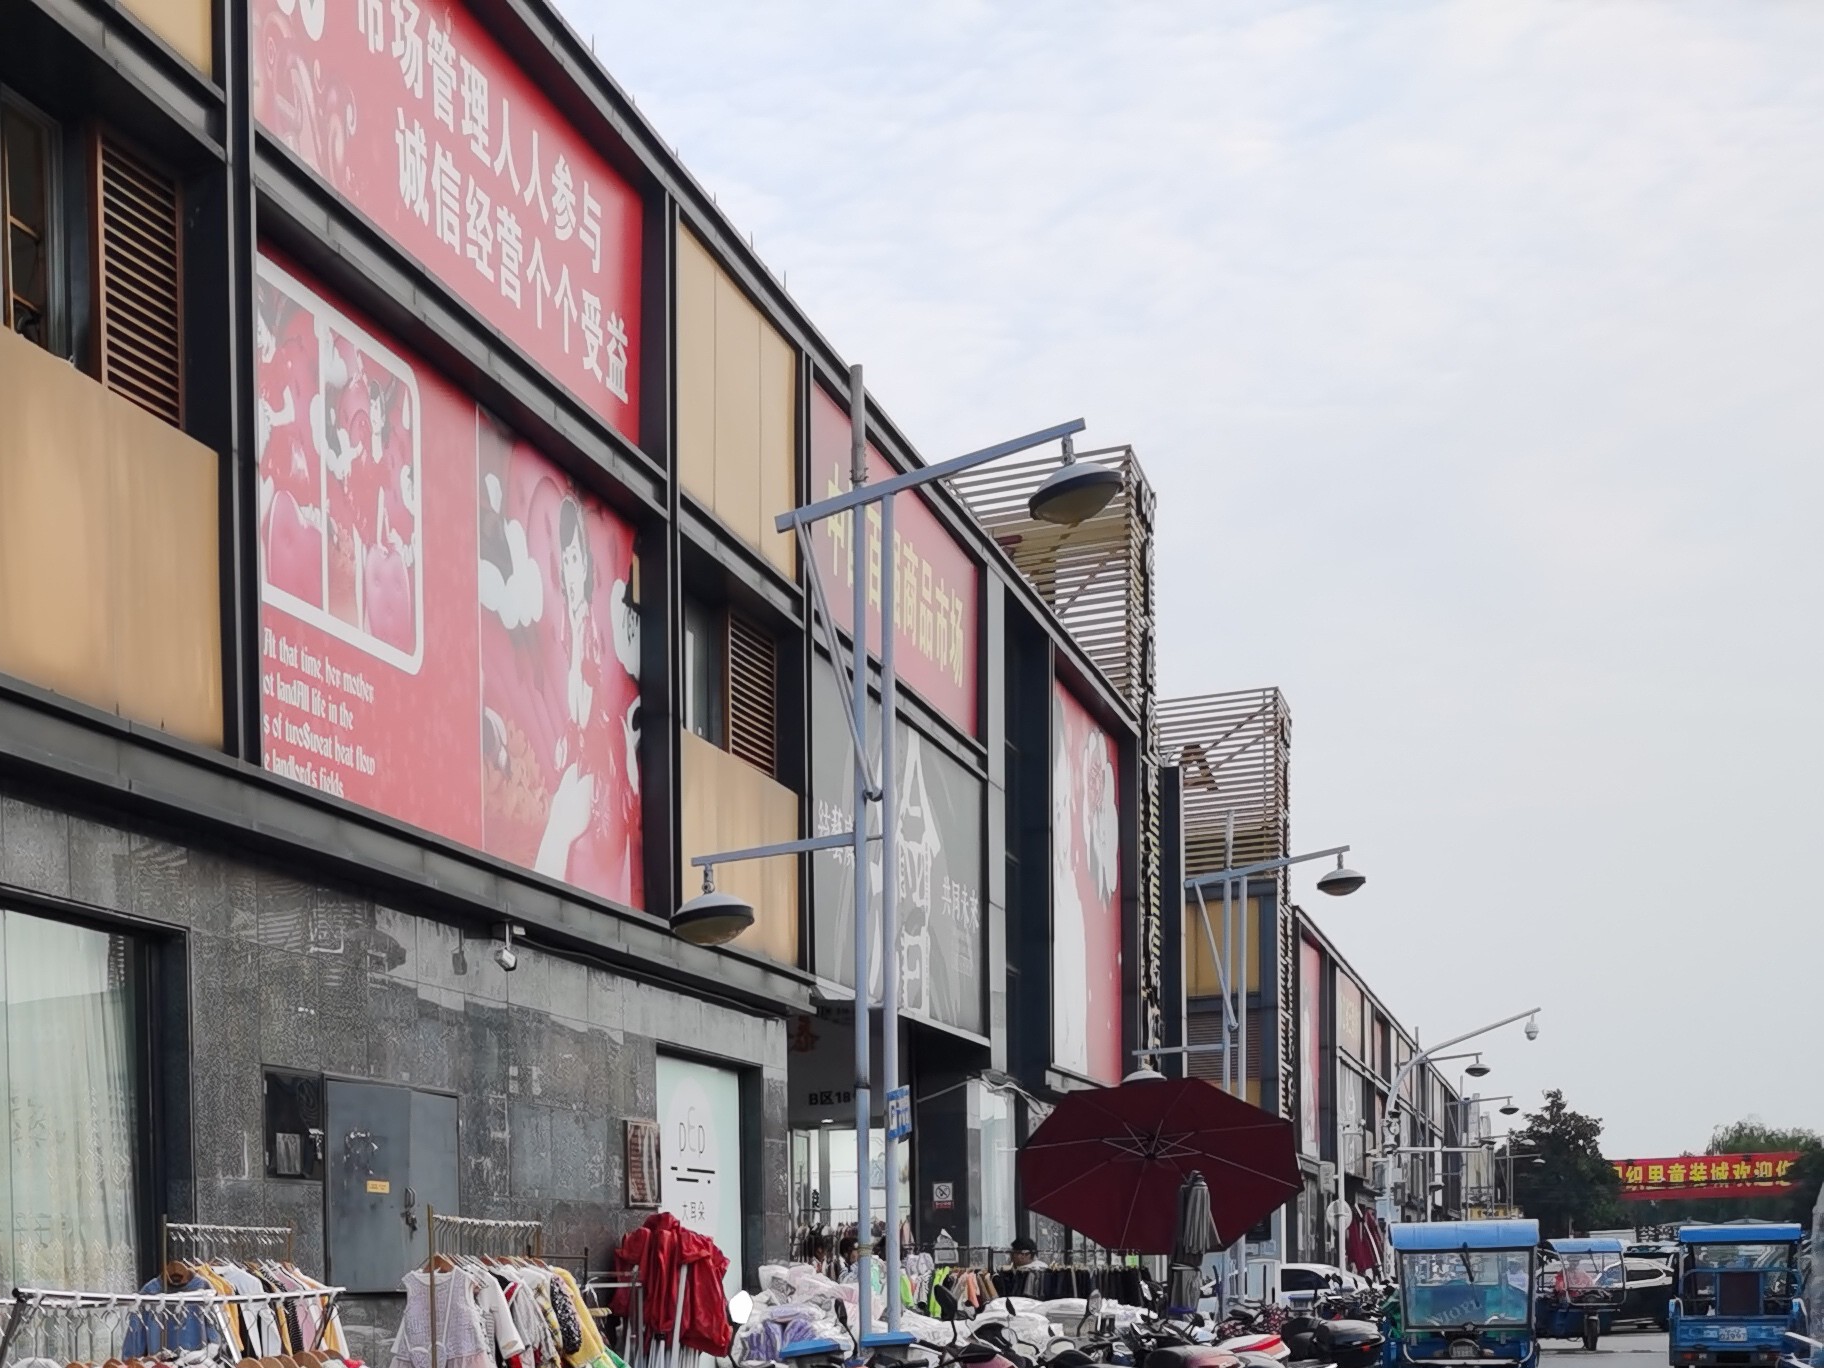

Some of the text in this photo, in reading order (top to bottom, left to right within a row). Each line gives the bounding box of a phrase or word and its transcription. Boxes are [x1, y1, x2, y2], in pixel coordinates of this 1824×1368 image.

[395, 106, 629, 404] 诚信经营个个受益
[263, 627, 276, 659] At
[279, 636, 299, 669] that
[272, 712, 282, 739] of
[328, 696, 338, 725] in
[339, 702, 354, 731] the
[808, 1090, 856, 1106] B区18
